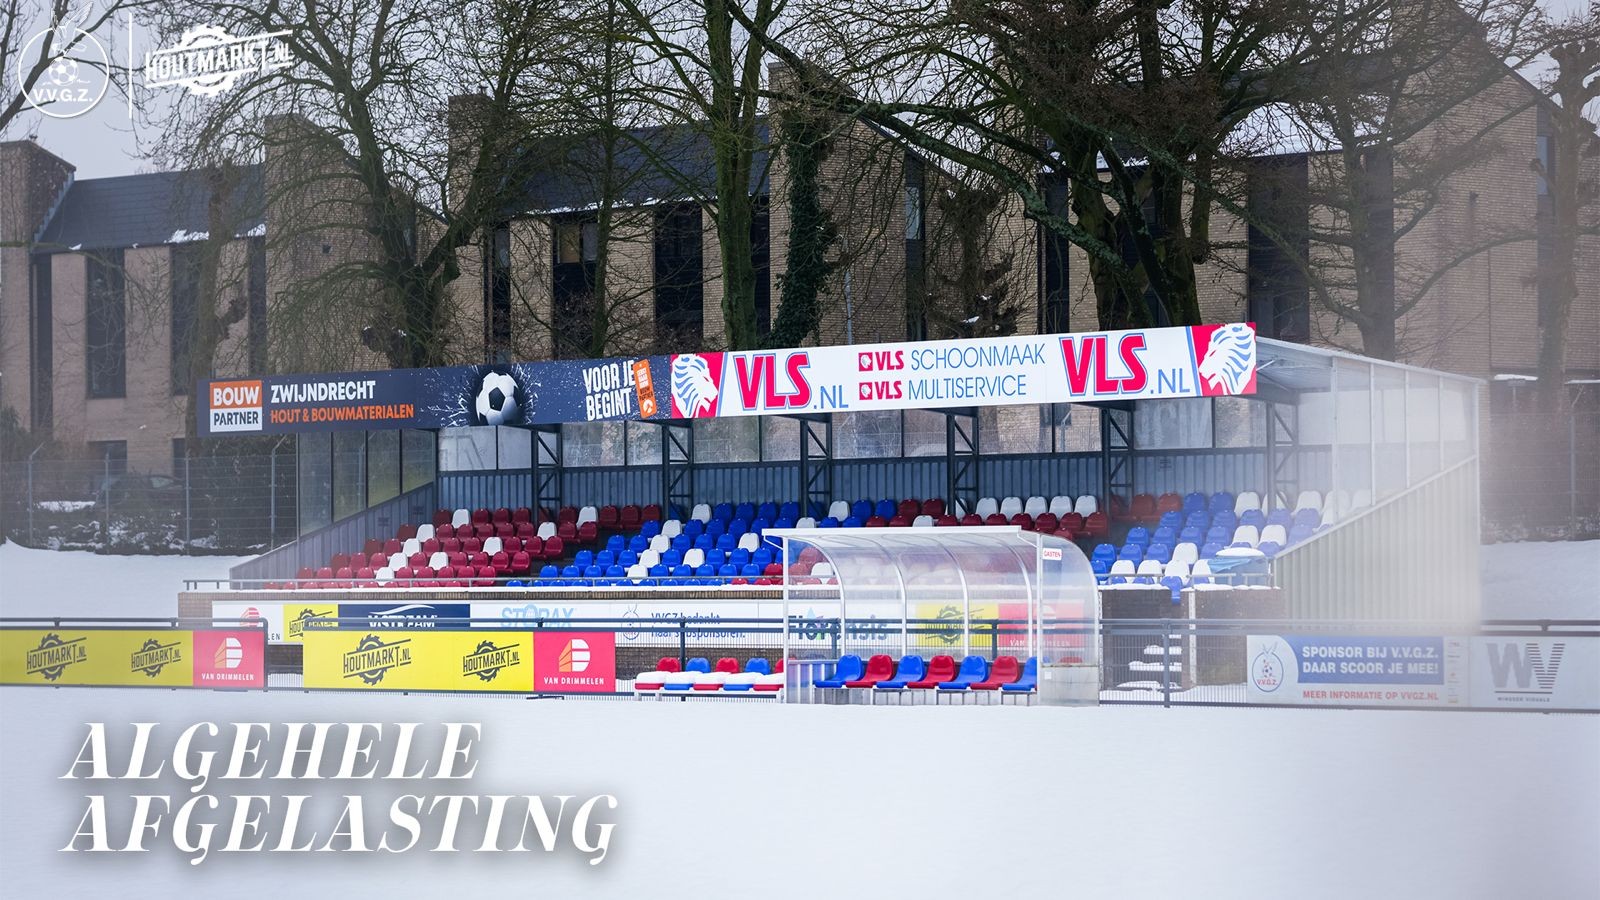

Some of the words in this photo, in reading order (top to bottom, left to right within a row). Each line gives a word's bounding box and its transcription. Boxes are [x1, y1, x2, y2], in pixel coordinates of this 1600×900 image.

[875, 350, 904, 370] VLS
[911, 343, 1046, 371] SCHOONMAAK
[582, 363, 621, 394] VOOR
[623, 360, 636, 388] JE
[874, 380, 903, 400] VLS
[908, 374, 1027, 400] MULTISERVICE
[213, 386, 260, 406] BOUW
[271, 380, 376, 403] ZWIJNDRECHT
[271, 408, 300, 424] HOUT
[303, 408, 310, 422] &
[312, 404, 414, 421] BOUWMATERIALEN
[585, 388, 632, 421] BEGINT
[213, 411, 259, 426] PARTNER
[27, 644, 87, 670] HOUTMARKT.NL
[131, 647, 182, 669] HOUTMARKT.NL
[343, 645, 412, 674] HOUTMARKT.NL
[462, 649, 520, 673] HOUTMARKT.NL
[1302, 646, 1363, 658] SPONSOR
[1367, 647, 1387, 658] BIJ
[1391, 647, 1439, 659] V.V.G.Z.
[201, 672, 214, 680] VAN
[216, 672, 255, 681] DRIMMELEN
[1302, 662, 1336, 673] DAAR
[1340, 662, 1384, 674] SCOOR
[1388, 662, 1403, 674] JE
[1407, 662, 1439, 674] MEE!
[543, 676, 560, 685] VAN
[561, 676, 605, 685] DRIMMELEN
[1303, 690, 1327, 699] MEER
[1330, 690, 1382, 700] INFORMATIE
[1386, 691, 1398, 700] OP
[1401, 691, 1439, 701] VVGZ.NL
